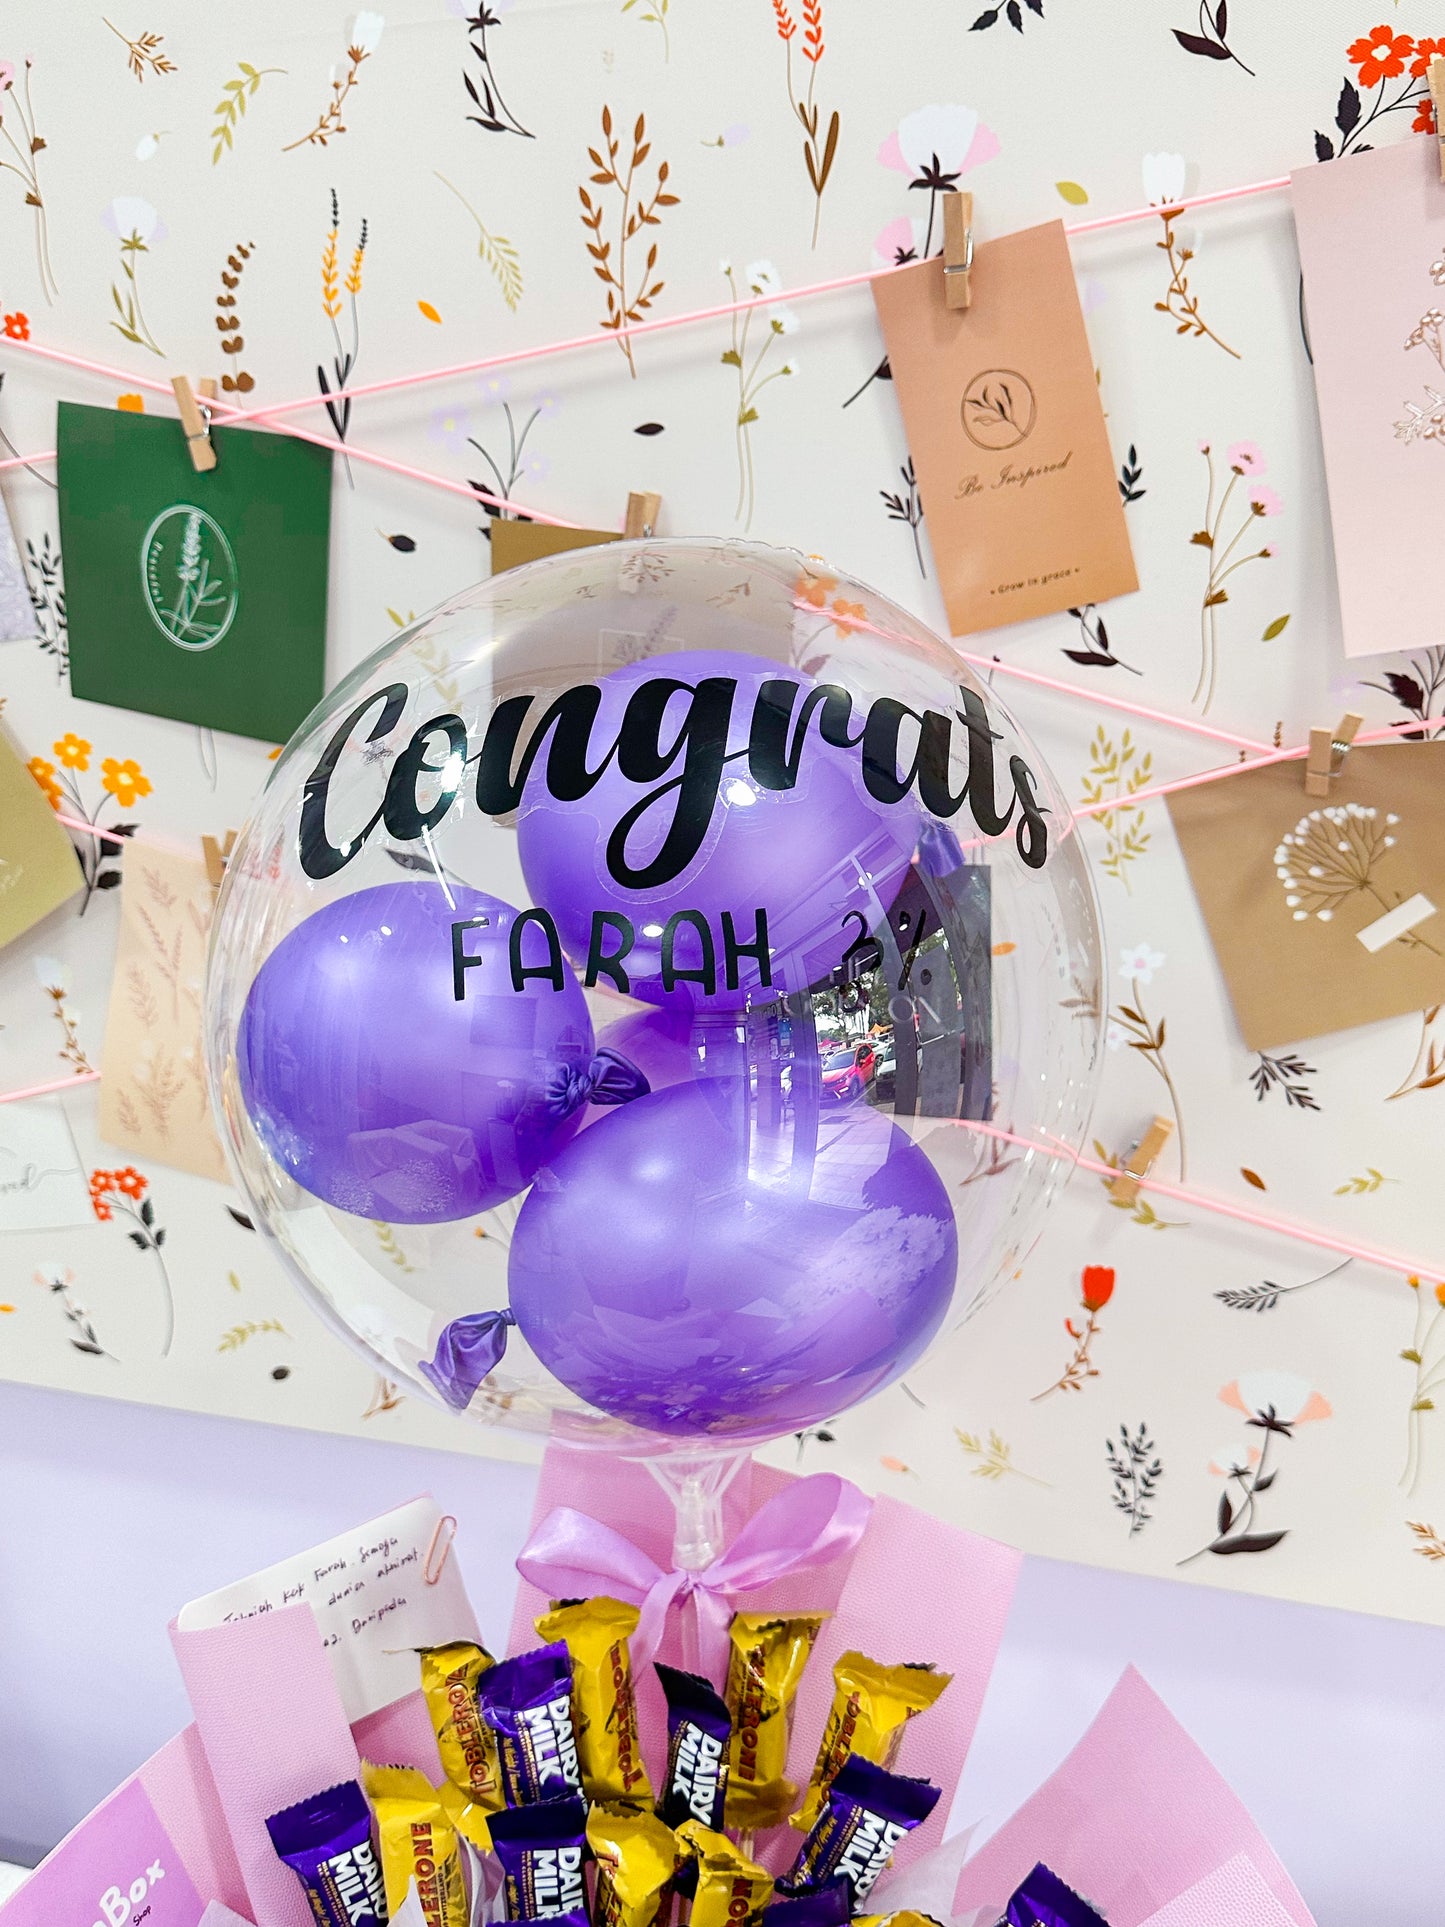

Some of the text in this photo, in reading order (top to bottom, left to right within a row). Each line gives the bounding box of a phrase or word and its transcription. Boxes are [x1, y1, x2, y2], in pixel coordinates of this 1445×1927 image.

[954, 450, 1074, 500] Be Inspired
[998, 582, 1025, 595] Grow
[1041, 567, 1072, 585] grace
[299, 676, 1053, 889] Congrats
[451, 908, 773, 1001] FARAH
[445, 1663, 498, 1795] TOBLERON
[523, 1705, 563, 1787] MILK
[549, 1695, 580, 1787] DAIRY
[672, 1721, 703, 1801] MILK
[690, 1732, 722, 1826] DAIRY
[411, 1822, 442, 1927] LERONE
[558, 1846, 584, 1910] DAI
[833, 1808, 887, 1882] MILK
[91, 1858, 166, 1927] Box
[133, 1905, 152, 1927] Shop
[328, 1850, 374, 1927] MILK
